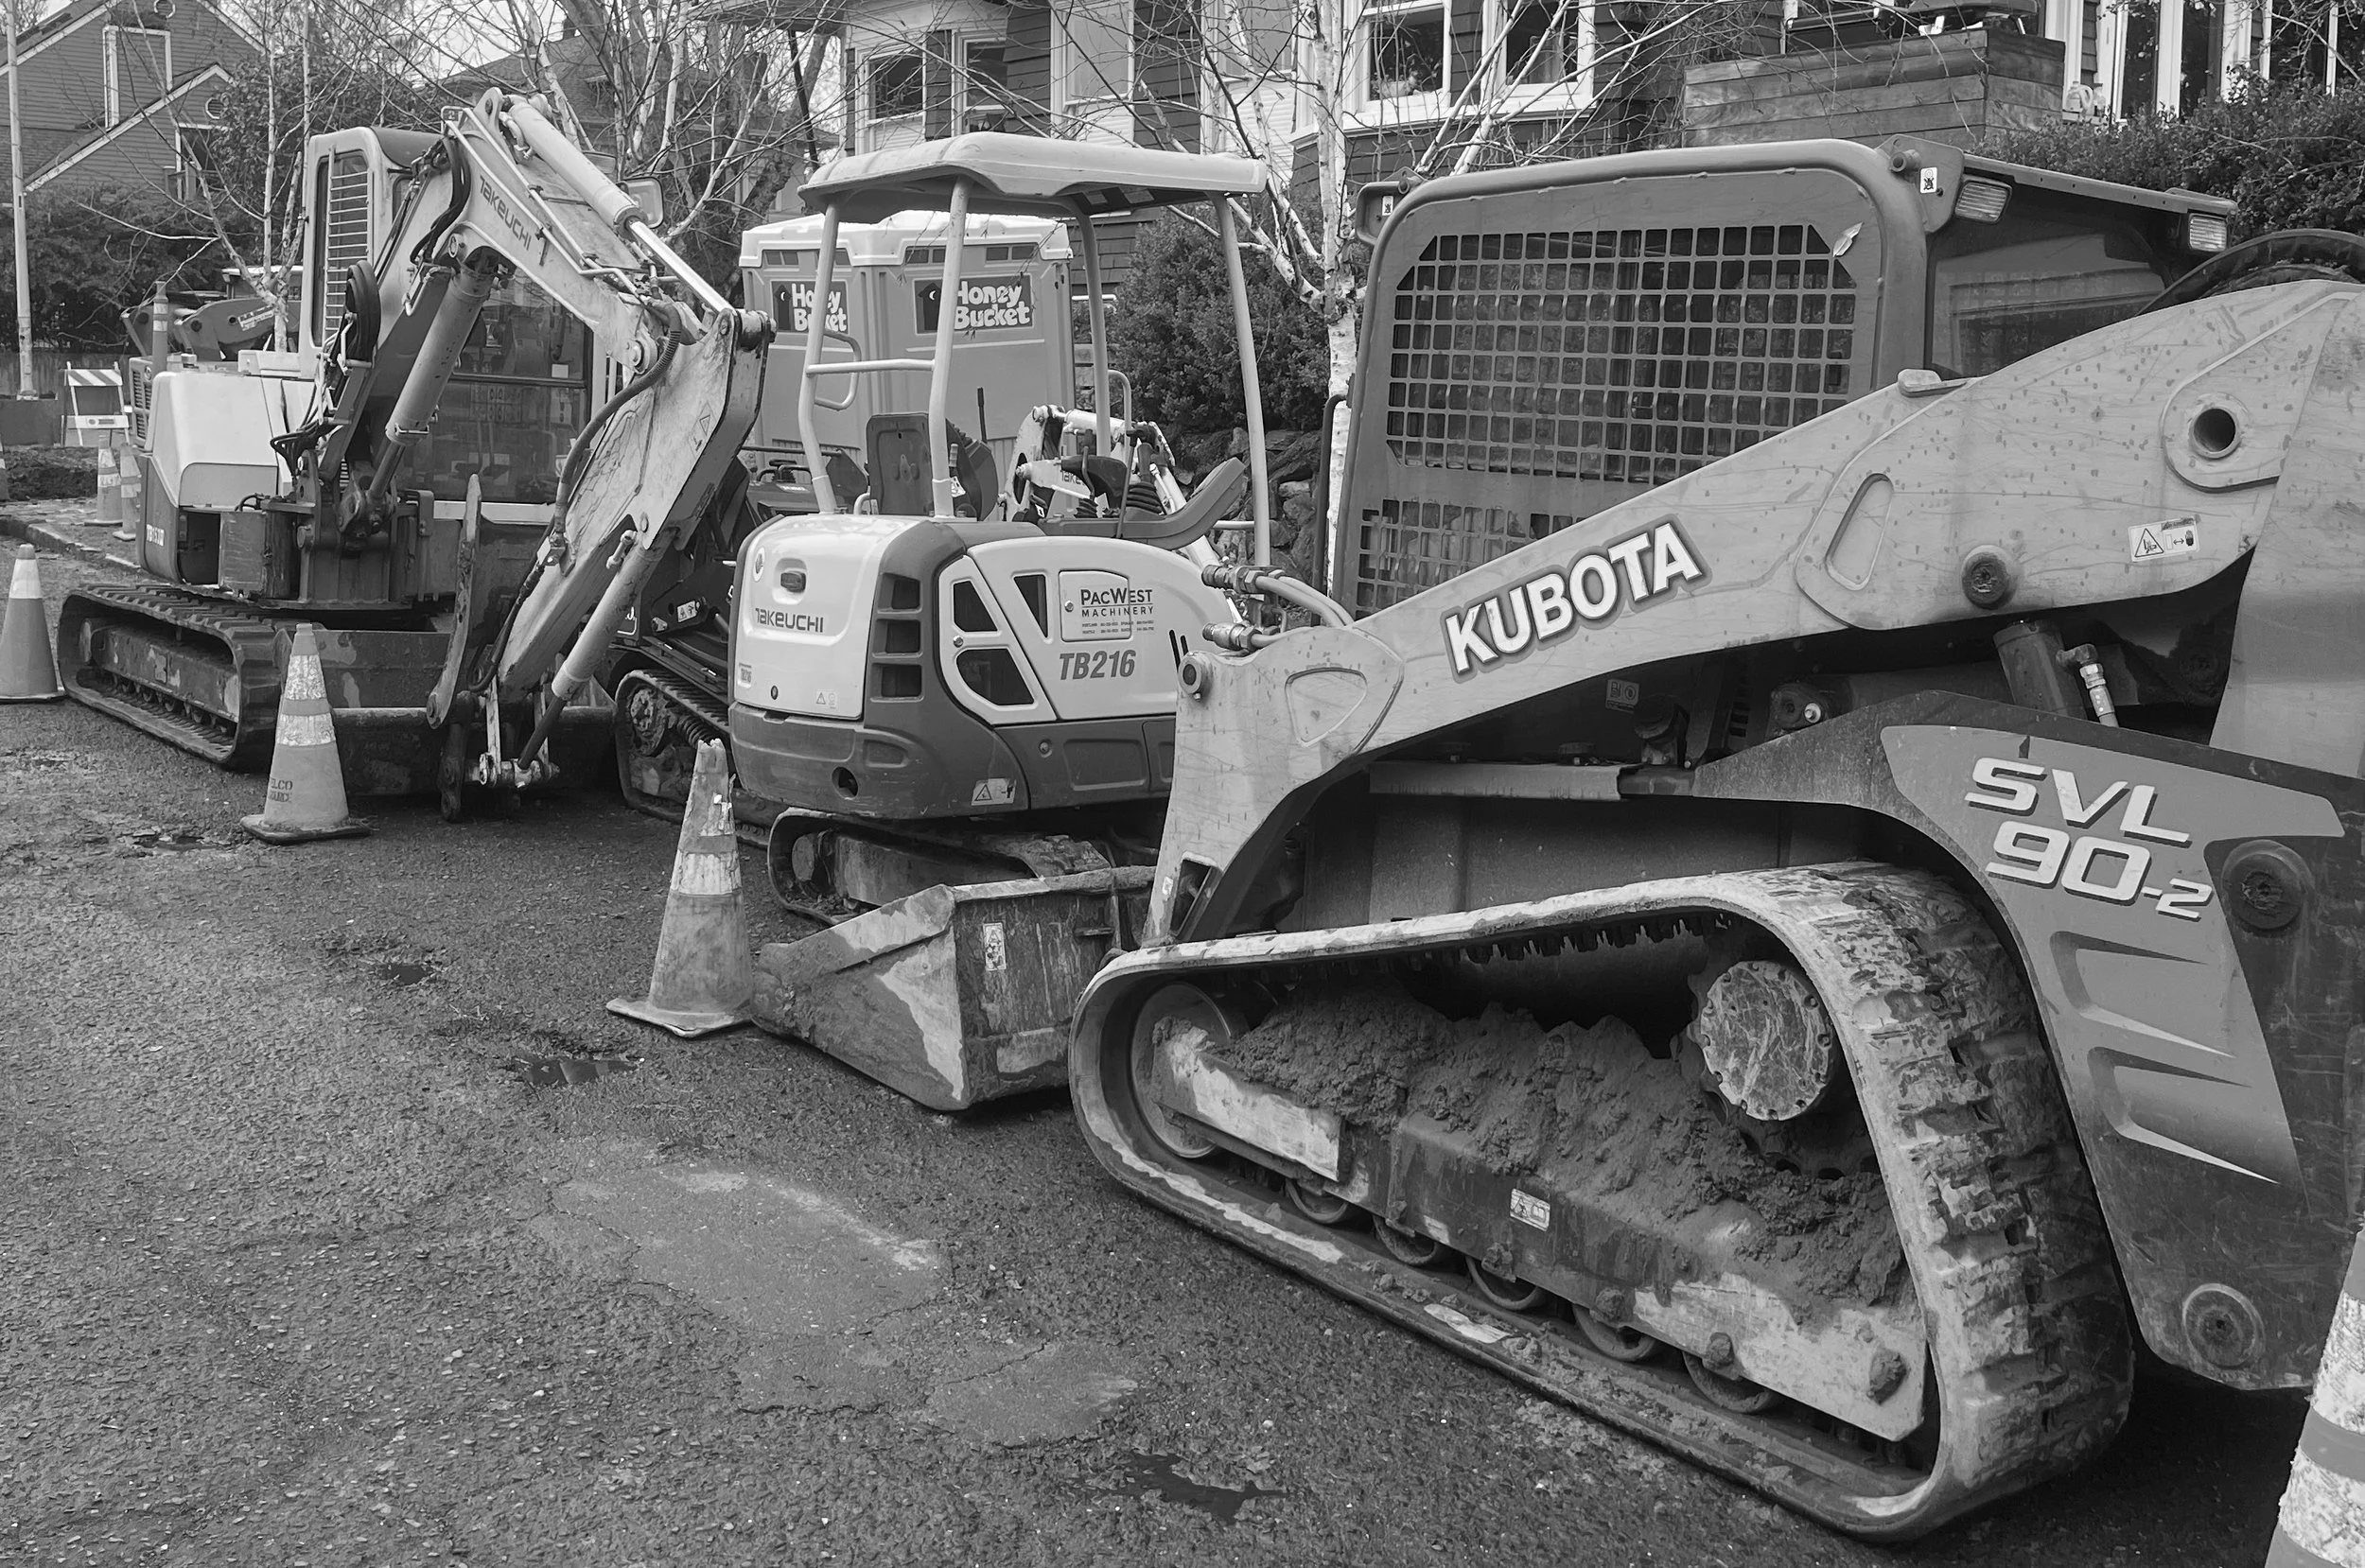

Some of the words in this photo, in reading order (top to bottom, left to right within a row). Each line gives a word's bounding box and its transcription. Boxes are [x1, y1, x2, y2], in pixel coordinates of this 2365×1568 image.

[954, 301, 1030, 330] Bucket
[1081, 606, 1153, 618] MACHINERY
[1445, 522, 1702, 674] KUBOTA
[1060, 650, 1136, 680] TB216
[1964, 757, 2193, 848] SVL
[1986, 821, 2214, 922] 90-2
